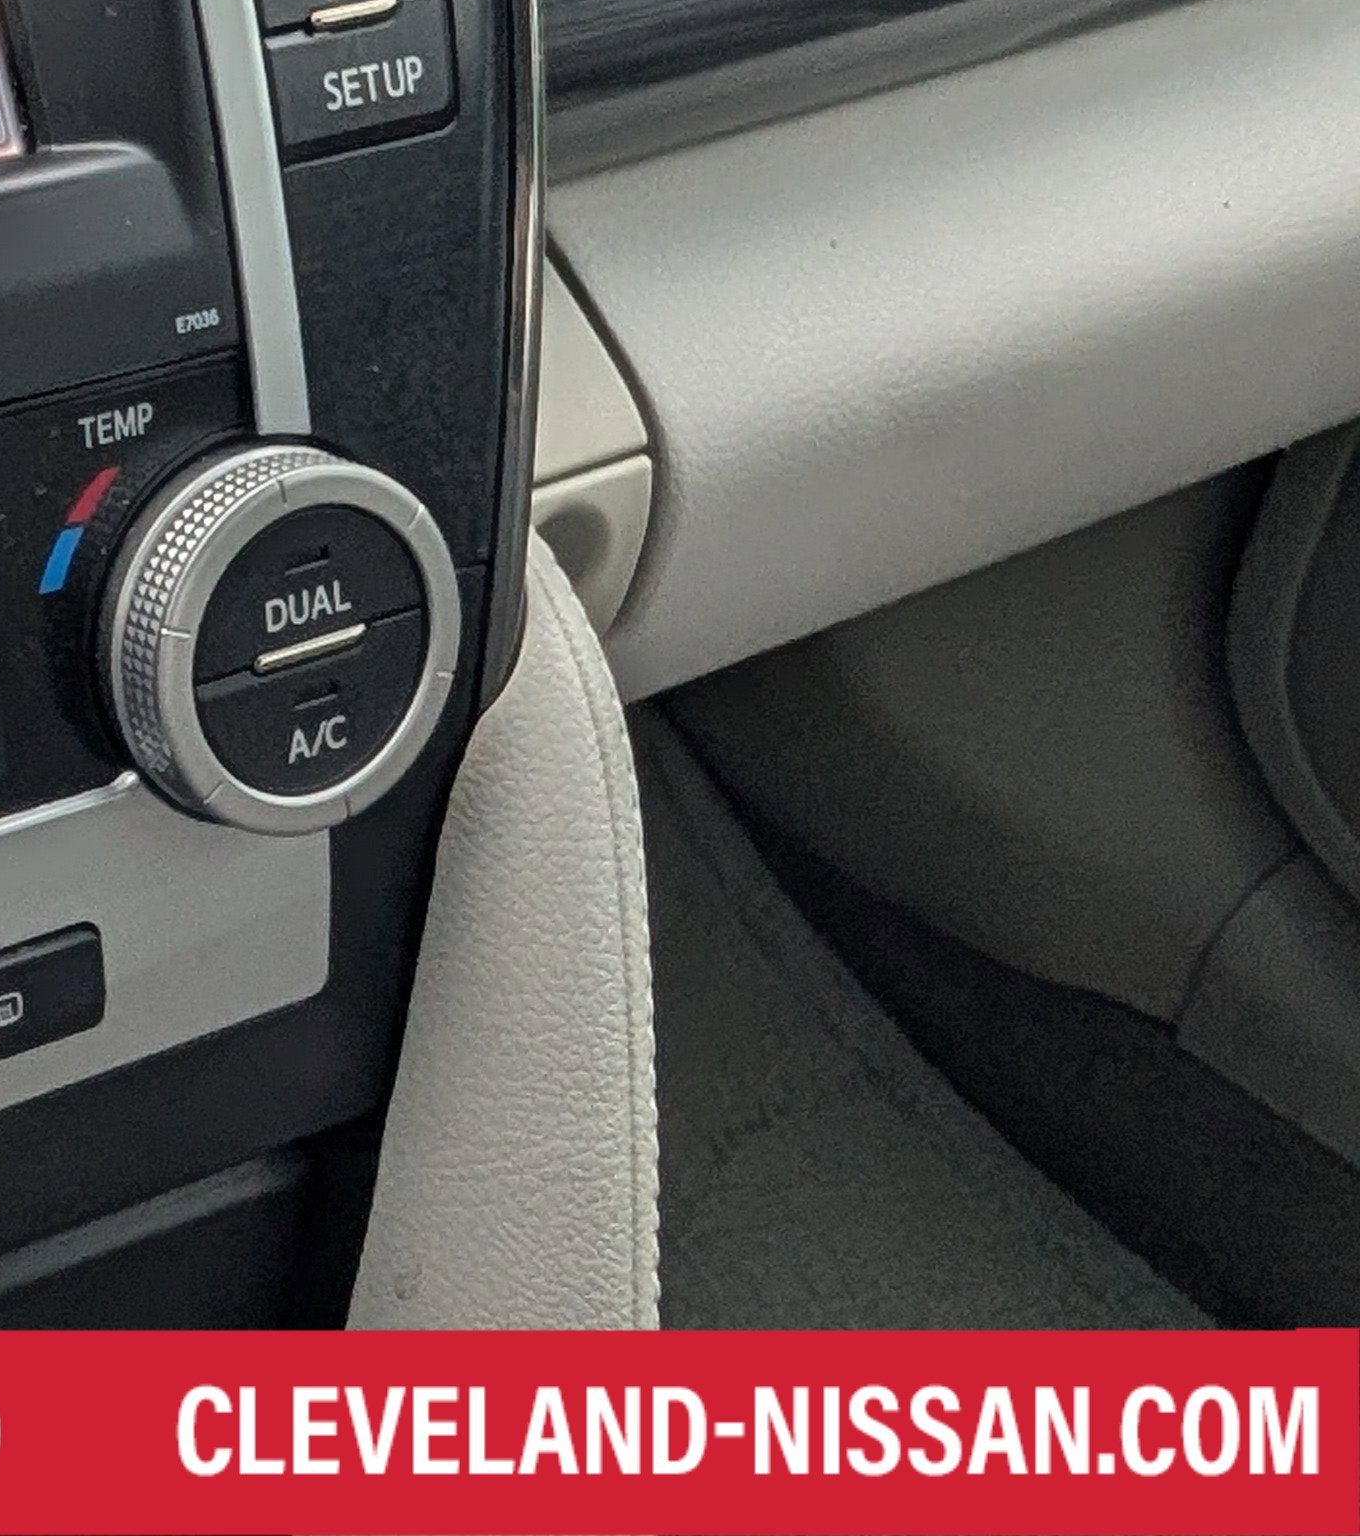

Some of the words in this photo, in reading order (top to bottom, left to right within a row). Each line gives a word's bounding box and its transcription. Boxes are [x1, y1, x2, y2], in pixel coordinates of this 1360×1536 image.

[323, 55, 423, 111] SETUP
[175, 307, 220, 335] E7036
[78, 402, 154, 450] TEMP
[265, 579, 352, 633] DUAL
[288, 715, 347, 764] A/C
